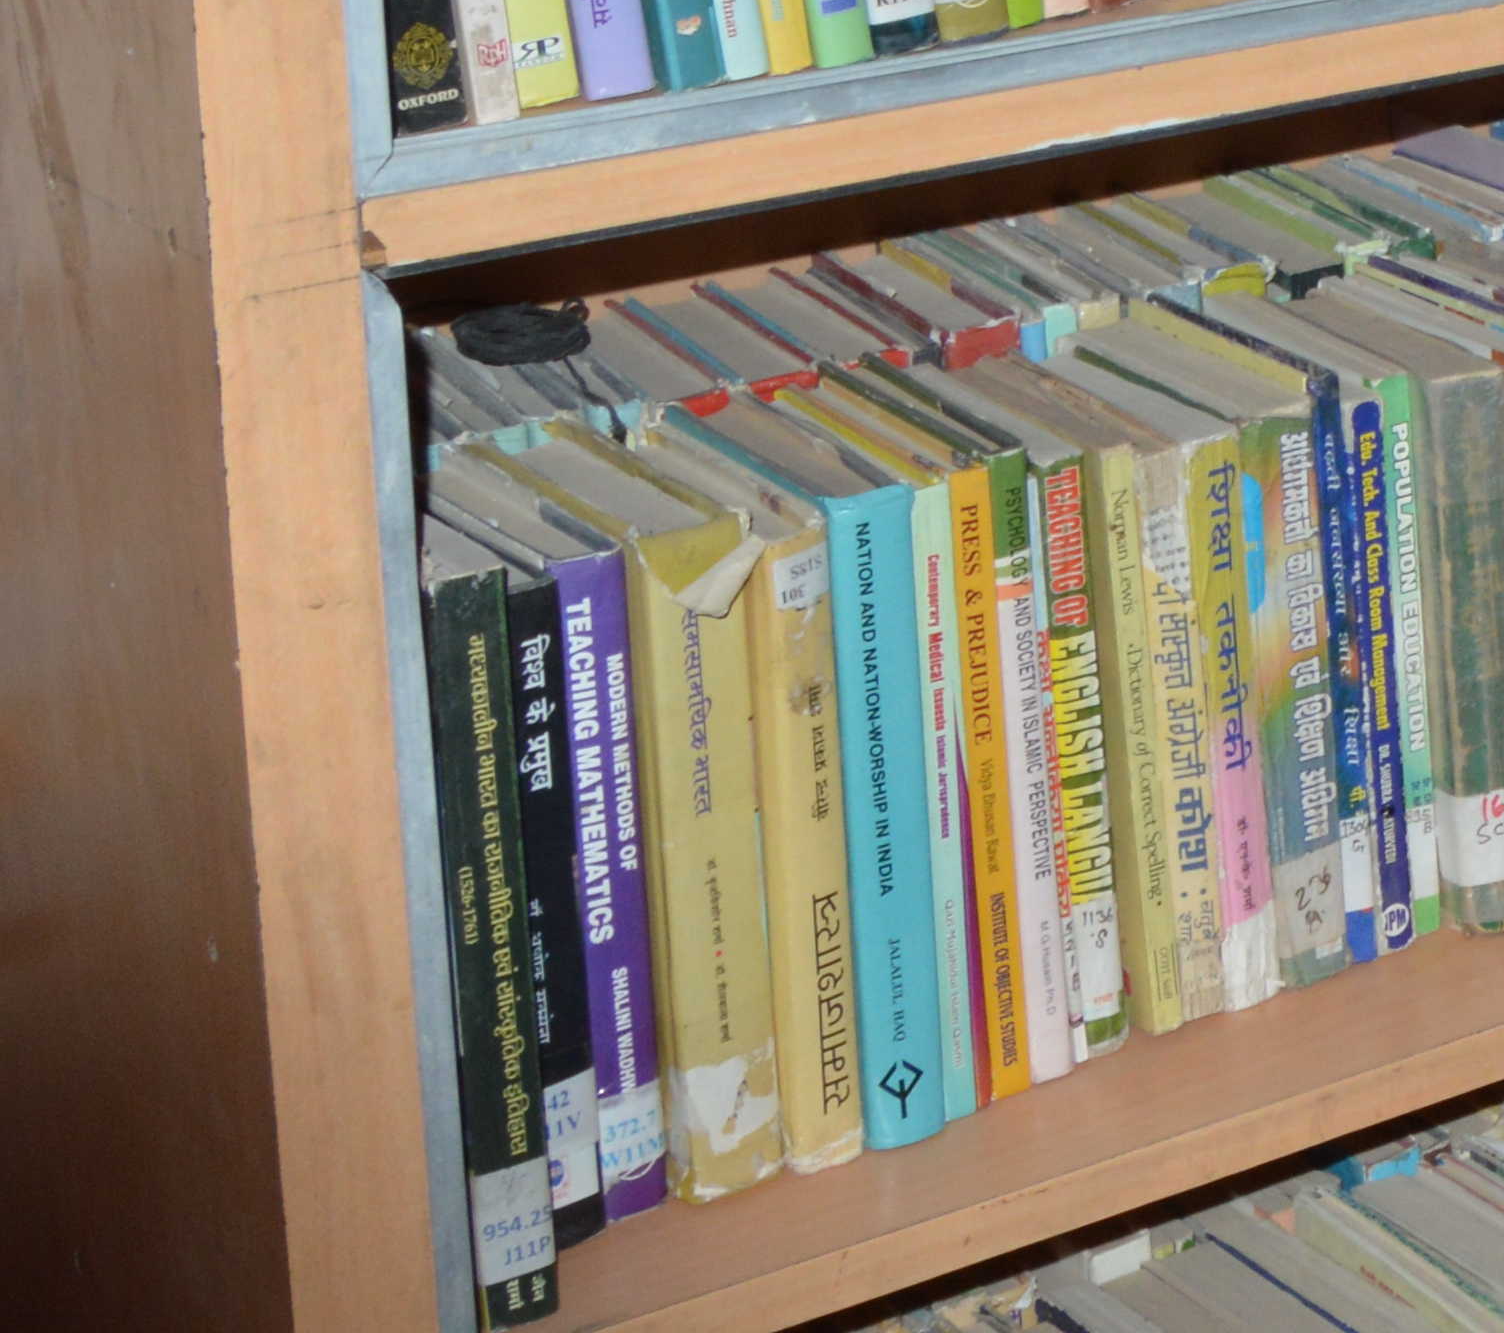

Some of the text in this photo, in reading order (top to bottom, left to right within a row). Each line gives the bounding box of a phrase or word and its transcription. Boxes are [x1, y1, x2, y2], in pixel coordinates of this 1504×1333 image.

[398, 88, 459, 111] OXFORD
[855, 522, 893, 898] NATION AND NATION-WORSHIP IN INDIA
[959, 503, 993, 746] PRESS & PREJUDICE
[1391, 422, 1426, 752] POPULATION EDUCATION
[563, 597, 615, 946] TEACHING MATHEMATICS
[604, 652, 637, 871] MODERN METHODS OF
